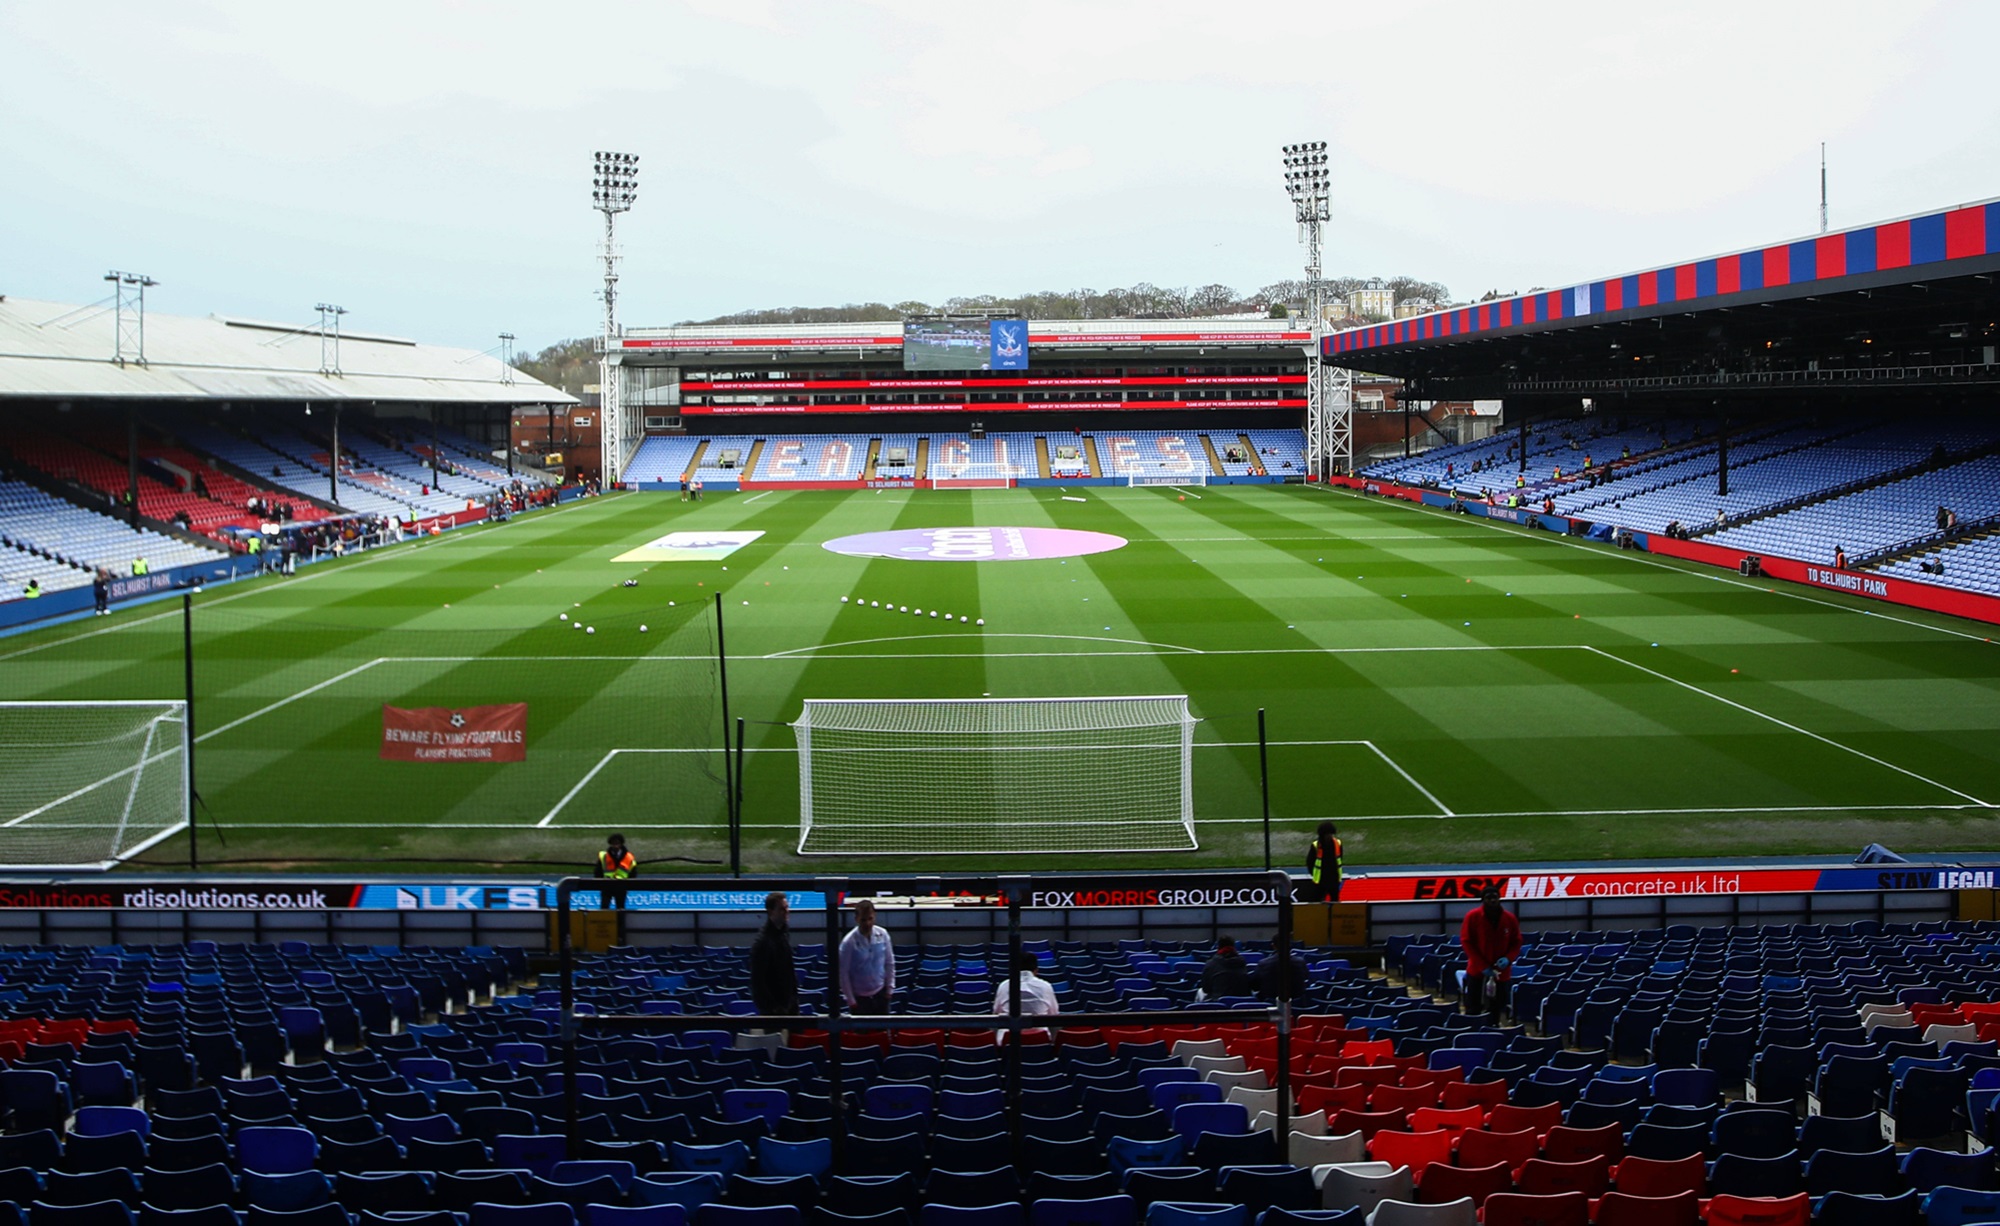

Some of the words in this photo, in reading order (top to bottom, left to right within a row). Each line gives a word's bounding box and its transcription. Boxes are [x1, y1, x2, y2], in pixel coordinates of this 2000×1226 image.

[1508, 510, 1518, 520] PARK
[112, 577, 150, 597] SELHURST
[152, 573, 170, 590] PARK
[1807, 568, 1818, 582] TO
[1820, 570, 1861, 591] SELHURST
[1864, 578, 1887, 596] PARK
[385, 728, 430, 744] BEWARE
[432, 731, 467, 745] FLYING
[466, 730, 522, 744] FOOTBALLS
[414, 748, 446, 758] PLAYERS
[448, 748, 492, 758] PRACTISING
[1582, 879, 1676, 896] concrete
[1681, 877, 1706, 895] uk
[1712, 875, 1740, 894] ltd
[1877, 872, 1933, 889] STAY
[0, 889, 113, 907] Solutions
[123, 888, 327, 908] rdisolutions.co.uk
[627, 893, 664, 906] YOUR
[664, 893, 728, 906] FACILITIES
[729, 893, 767, 906] NEEDS
